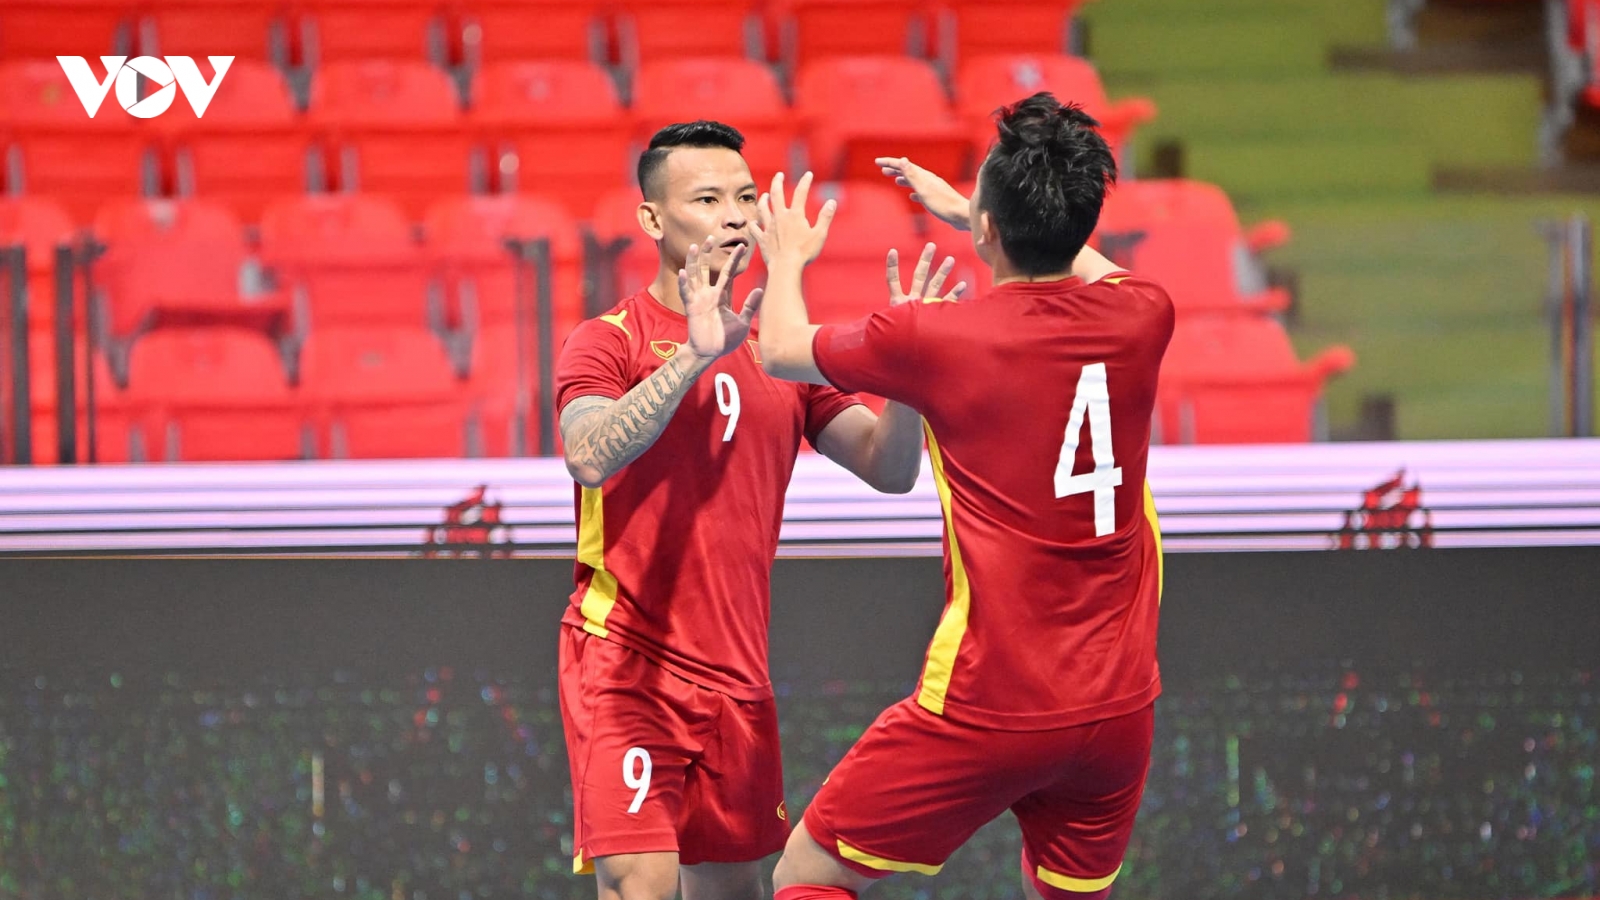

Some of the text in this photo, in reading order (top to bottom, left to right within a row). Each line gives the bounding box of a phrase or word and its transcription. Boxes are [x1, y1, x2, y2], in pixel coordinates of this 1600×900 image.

[714, 372, 741, 442] 9
[1053, 362, 1123, 537] 4
[622, 747, 653, 814] 9
